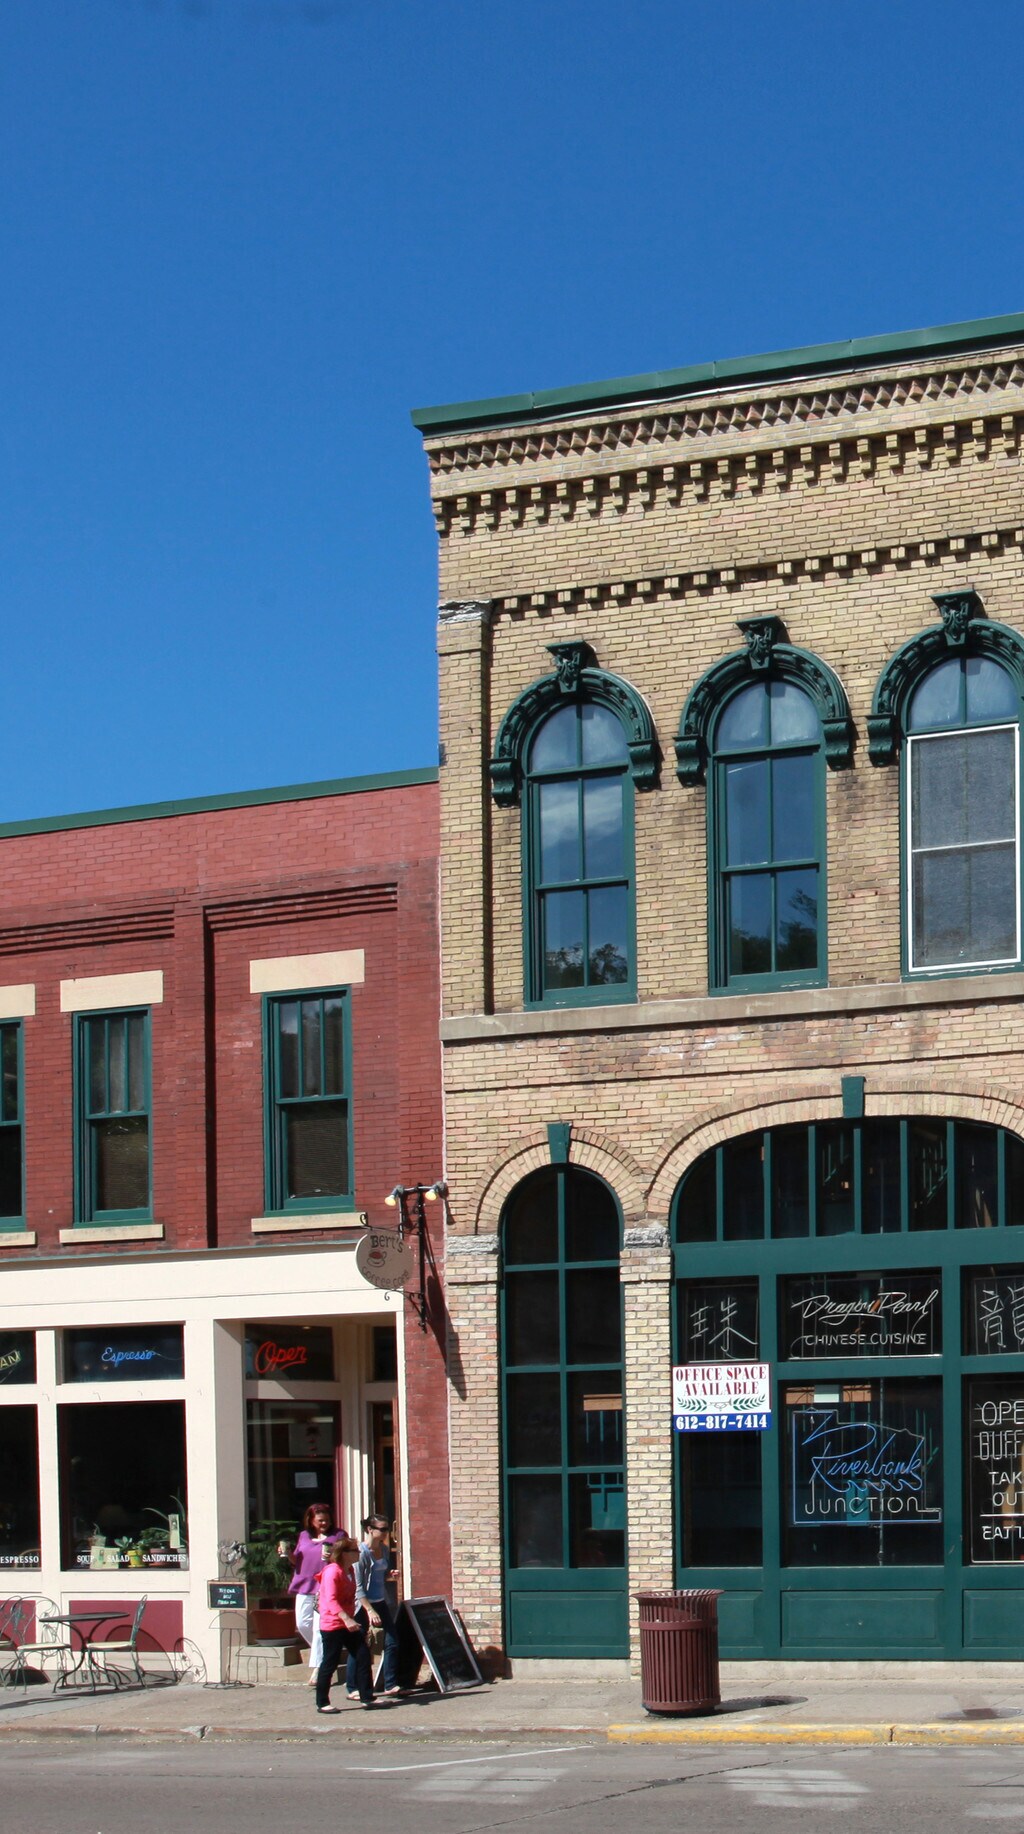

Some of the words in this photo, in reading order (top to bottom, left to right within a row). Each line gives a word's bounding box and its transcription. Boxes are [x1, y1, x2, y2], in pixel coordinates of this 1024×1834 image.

[370, 1234, 404, 1254] Bert's
[791, 1294, 884, 1326] Dragon
[877, 1290, 939, 1316] Pearl
[690, 1296, 758, 1352] 珠
[804, 1333, 868, 1346] CHINESE
[870, 1332, 928, 1345] CUISINE
[101, 1347, 156, 1368] Espresso
[255, 1341, 307, 1374] Open
[676, 1367, 722, 1382] OFFICE
[726, 1366, 767, 1380] SPACE
[684, 1381, 760, 1397] AVAILABLE
[675, 1414, 768, 1430] 612-817-7414
[801, 1423, 925, 1493] Riverbank
[804, 1493, 932, 1515] JUNCTION
[982, 1525, 1012, 1540] EAT
[0, 1556, 39, 1564] ESPRESSO
[77, 1555, 95, 1563] SOUP
[107, 1554, 130, 1563] SALAD
[142, 1554, 187, 1563] SANDWICHES
